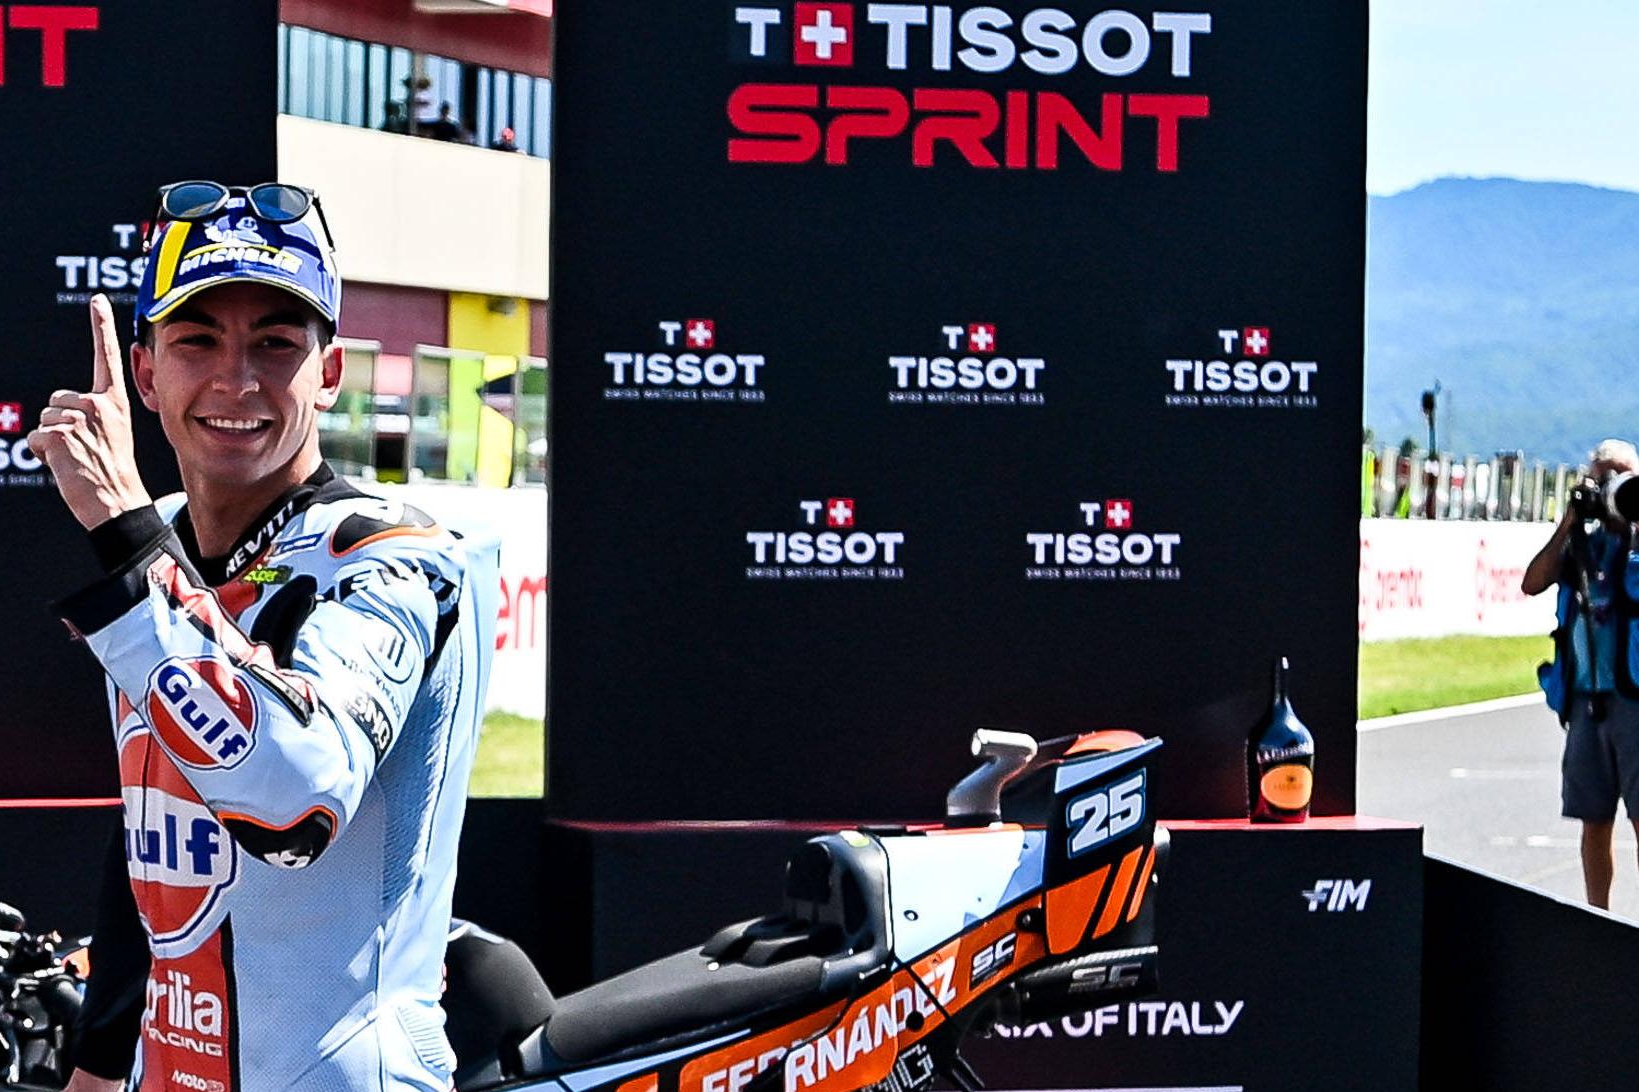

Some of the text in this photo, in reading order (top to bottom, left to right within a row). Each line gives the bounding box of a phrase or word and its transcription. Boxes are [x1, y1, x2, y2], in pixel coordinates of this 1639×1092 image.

[868, 4, 1211, 77] TISSOT
[728, 84, 1209, 172] SPRINT
[604, 352, 765, 385] TISSOT
[888, 356, 1045, 388] TISSOT
[1165, 359, 1317, 391] TISSOT
[746, 532, 904, 564] TISSOT
[1026, 532, 1180, 565] TISSOT
[158, 664, 249, 767] Gulf
[1068, 772, 1145, 854] 25
[124, 812, 221, 876] ulf
[1302, 879, 1371, 912] FIM
[1127, 1001, 1244, 1036] ITALY
